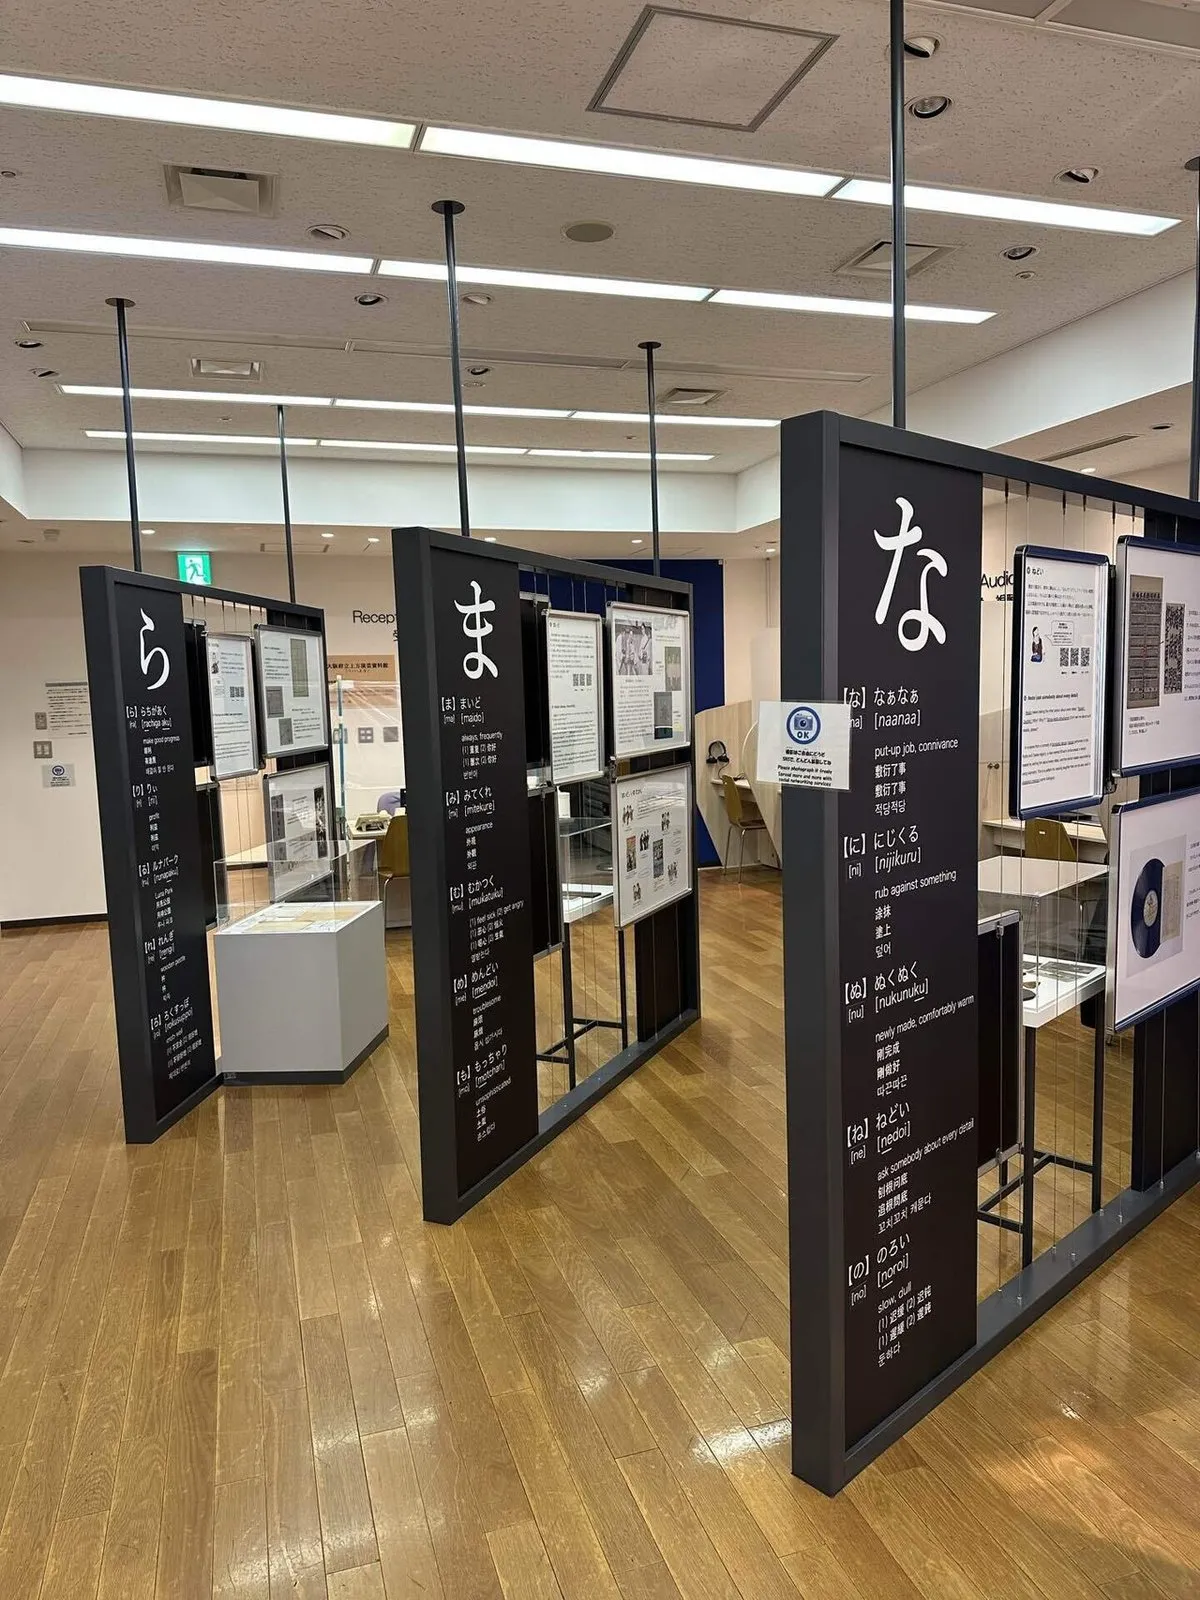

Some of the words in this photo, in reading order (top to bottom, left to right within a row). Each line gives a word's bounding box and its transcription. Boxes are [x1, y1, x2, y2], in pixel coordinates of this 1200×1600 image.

[873, 497, 948, 652] な
[352, 610, 397, 624] Recep
[454, 580, 498, 679] ま
[140, 607, 170, 690] ら
[460, 696, 481, 710] まいど
[873, 686, 919, 706] なぁなぁ
[849, 715, 863, 729] na]
[874, 709, 921, 730] [naanaa]
[797, 731, 809, 739] OK
[874, 746, 901, 759] put-up
[902, 742, 917, 756] job,
[918, 738, 959, 752] connivance
[464, 786, 492, 801] みてくれ
[875, 800, 907, 816] 적당적당
[874, 825, 919, 850] にじくる
[849, 863, 862, 879] [ni]
[875, 847, 921, 874] [nijikuru]
[468, 875, 494, 894] むかつく
[874, 886, 889, 900] rub
[890, 879, 919, 897] against
[920, 870, 957, 888] something
[471, 962, 499, 983] めんどい
[874, 961, 918, 991] ぬくぬく
[848, 1005, 864, 1024] [nu]
[875, 978, 929, 1013] [nukunuku]
[875, 1026, 896, 1043] newly
[896, 1018, 918, 1035] made,
[918, 1002, 956, 1025] comfortably
[957, 995, 975, 1009] warm
[876, 1102, 911, 1131] ねどい
[850, 1145, 866, 1165] [ne]
[877, 1121, 911, 1153] [nedoi]
[877, 1167, 889, 1181] ask
[890, 1148, 923, 1174] somebody
[924, 1138, 941, 1155] about
[942, 1129, 958, 1145] every
[958, 1117, 975, 1135] detail
[876, 1233, 911, 1264] のろい
[851, 1284, 867, 1306] [no]
[877, 1253, 909, 1288] [noroi]
[898, 1281, 912, 1299] dull
[878, 1316, 889, 1333] (1)
[878, 1333, 889, 1350] (1)
